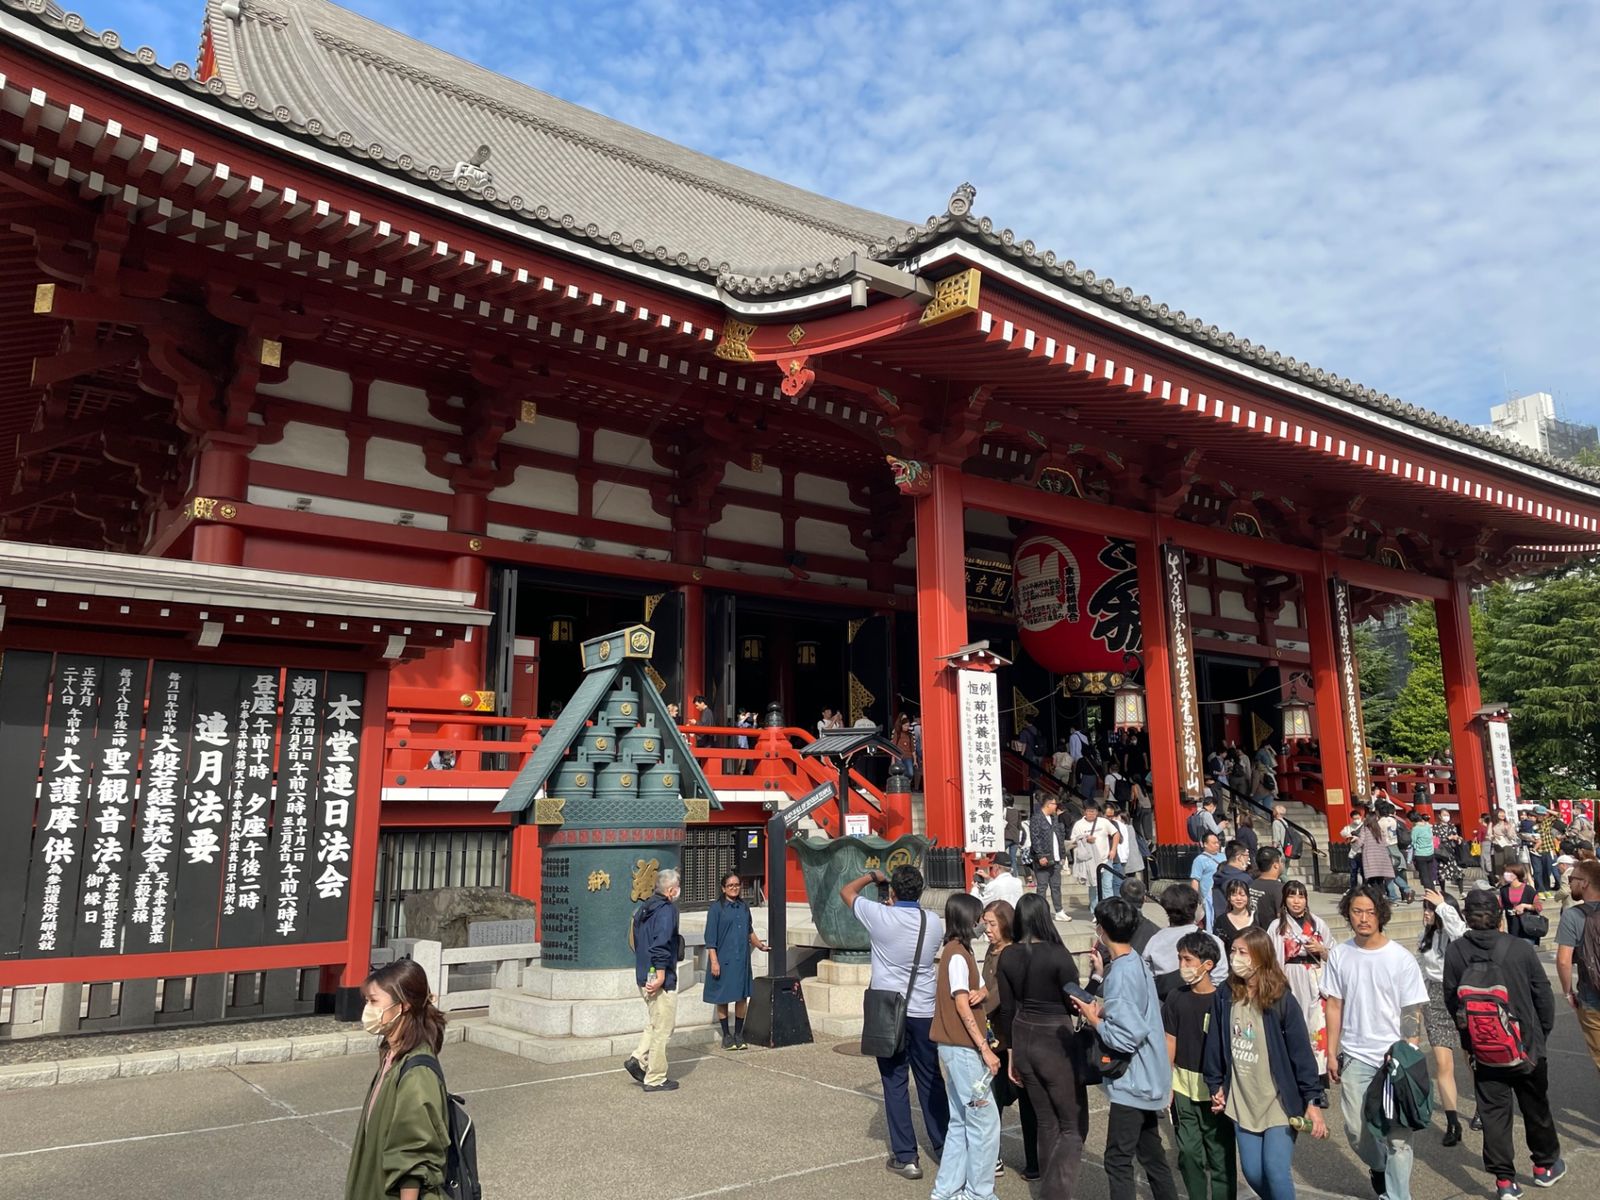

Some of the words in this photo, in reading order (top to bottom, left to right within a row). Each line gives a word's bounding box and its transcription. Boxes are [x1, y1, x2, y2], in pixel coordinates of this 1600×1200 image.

[61, 667, 79, 705] 二十八日
[79, 667, 97, 706] 正五九月
[290, 676, 317, 716] 朝座
[967, 680, 992, 696] 恒例
[64, 708, 83, 745] 午前十時
[288, 717, 303, 761] 至九月末日
[302, 717, 316, 761] 自四月一日
[973, 700, 990, 739] 菊供養
[975, 741, 985, 766] 延命
[42, 747, 84, 864] 大護摩供
[92, 748, 131, 862] 聖観音法
[141, 733, 182, 863] 大般若経転読会
[184, 712, 230, 864] 連月法要
[286, 762, 309, 815] 午前六時
[315, 694, 361, 898] 本堂連日法会
[279, 816, 295, 862] 至三月末日
[293, 816, 308, 862] 自十月一日
[84, 874, 104, 924] 御縁日
[276, 863, 301, 936] 午前六時半
